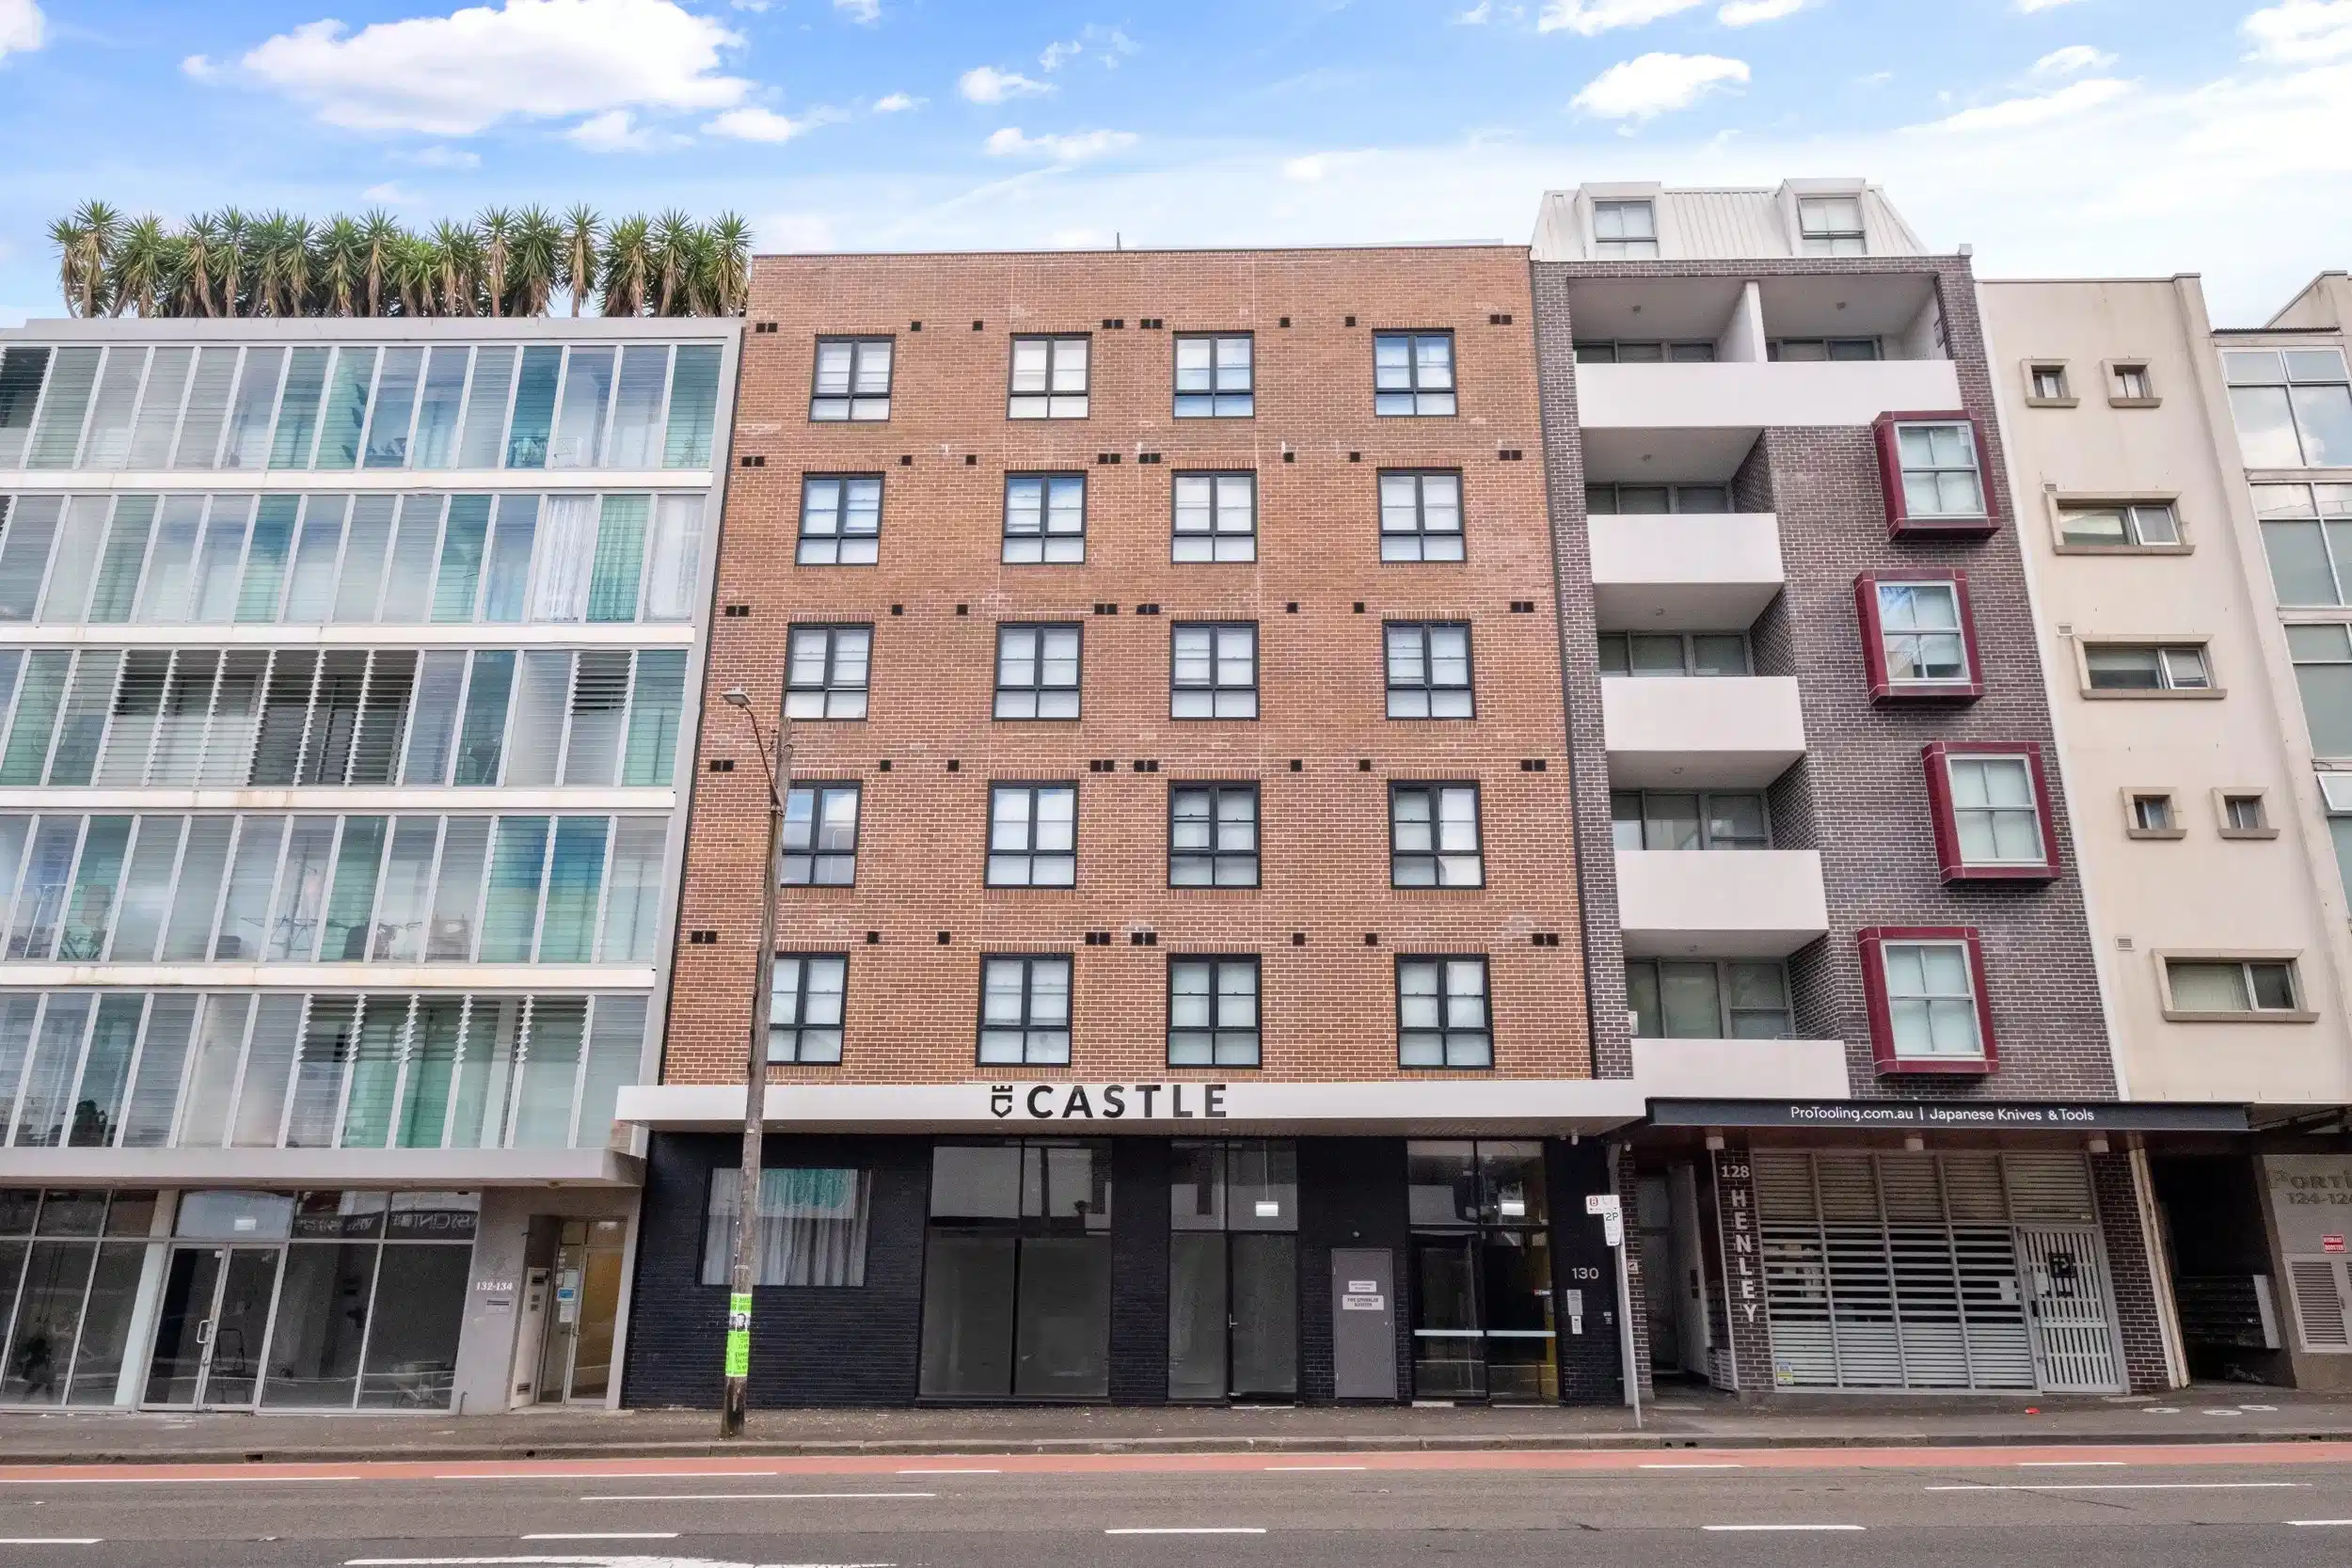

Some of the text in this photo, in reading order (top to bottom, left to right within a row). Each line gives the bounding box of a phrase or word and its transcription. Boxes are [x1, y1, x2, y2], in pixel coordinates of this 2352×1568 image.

[1026, 1085, 1227, 1118] CASTLE
[1790, 1106, 1914, 1121] ProTooling.com.au
[1930, 1108, 1994, 1122] Japanese
[1997, 1109, 2042, 1121] Knives
[2048, 1109, 2059, 1121] &
[2061, 1109, 2095, 1121] Tools
[1721, 1165, 1751, 1179] 128
[1605, 1212, 1619, 1222] 2P
[1731, 1189, 1757, 1323] HENLEY
[1571, 1267, 1599, 1279] 130
[475, 1281, 513, 1291] 132-134
